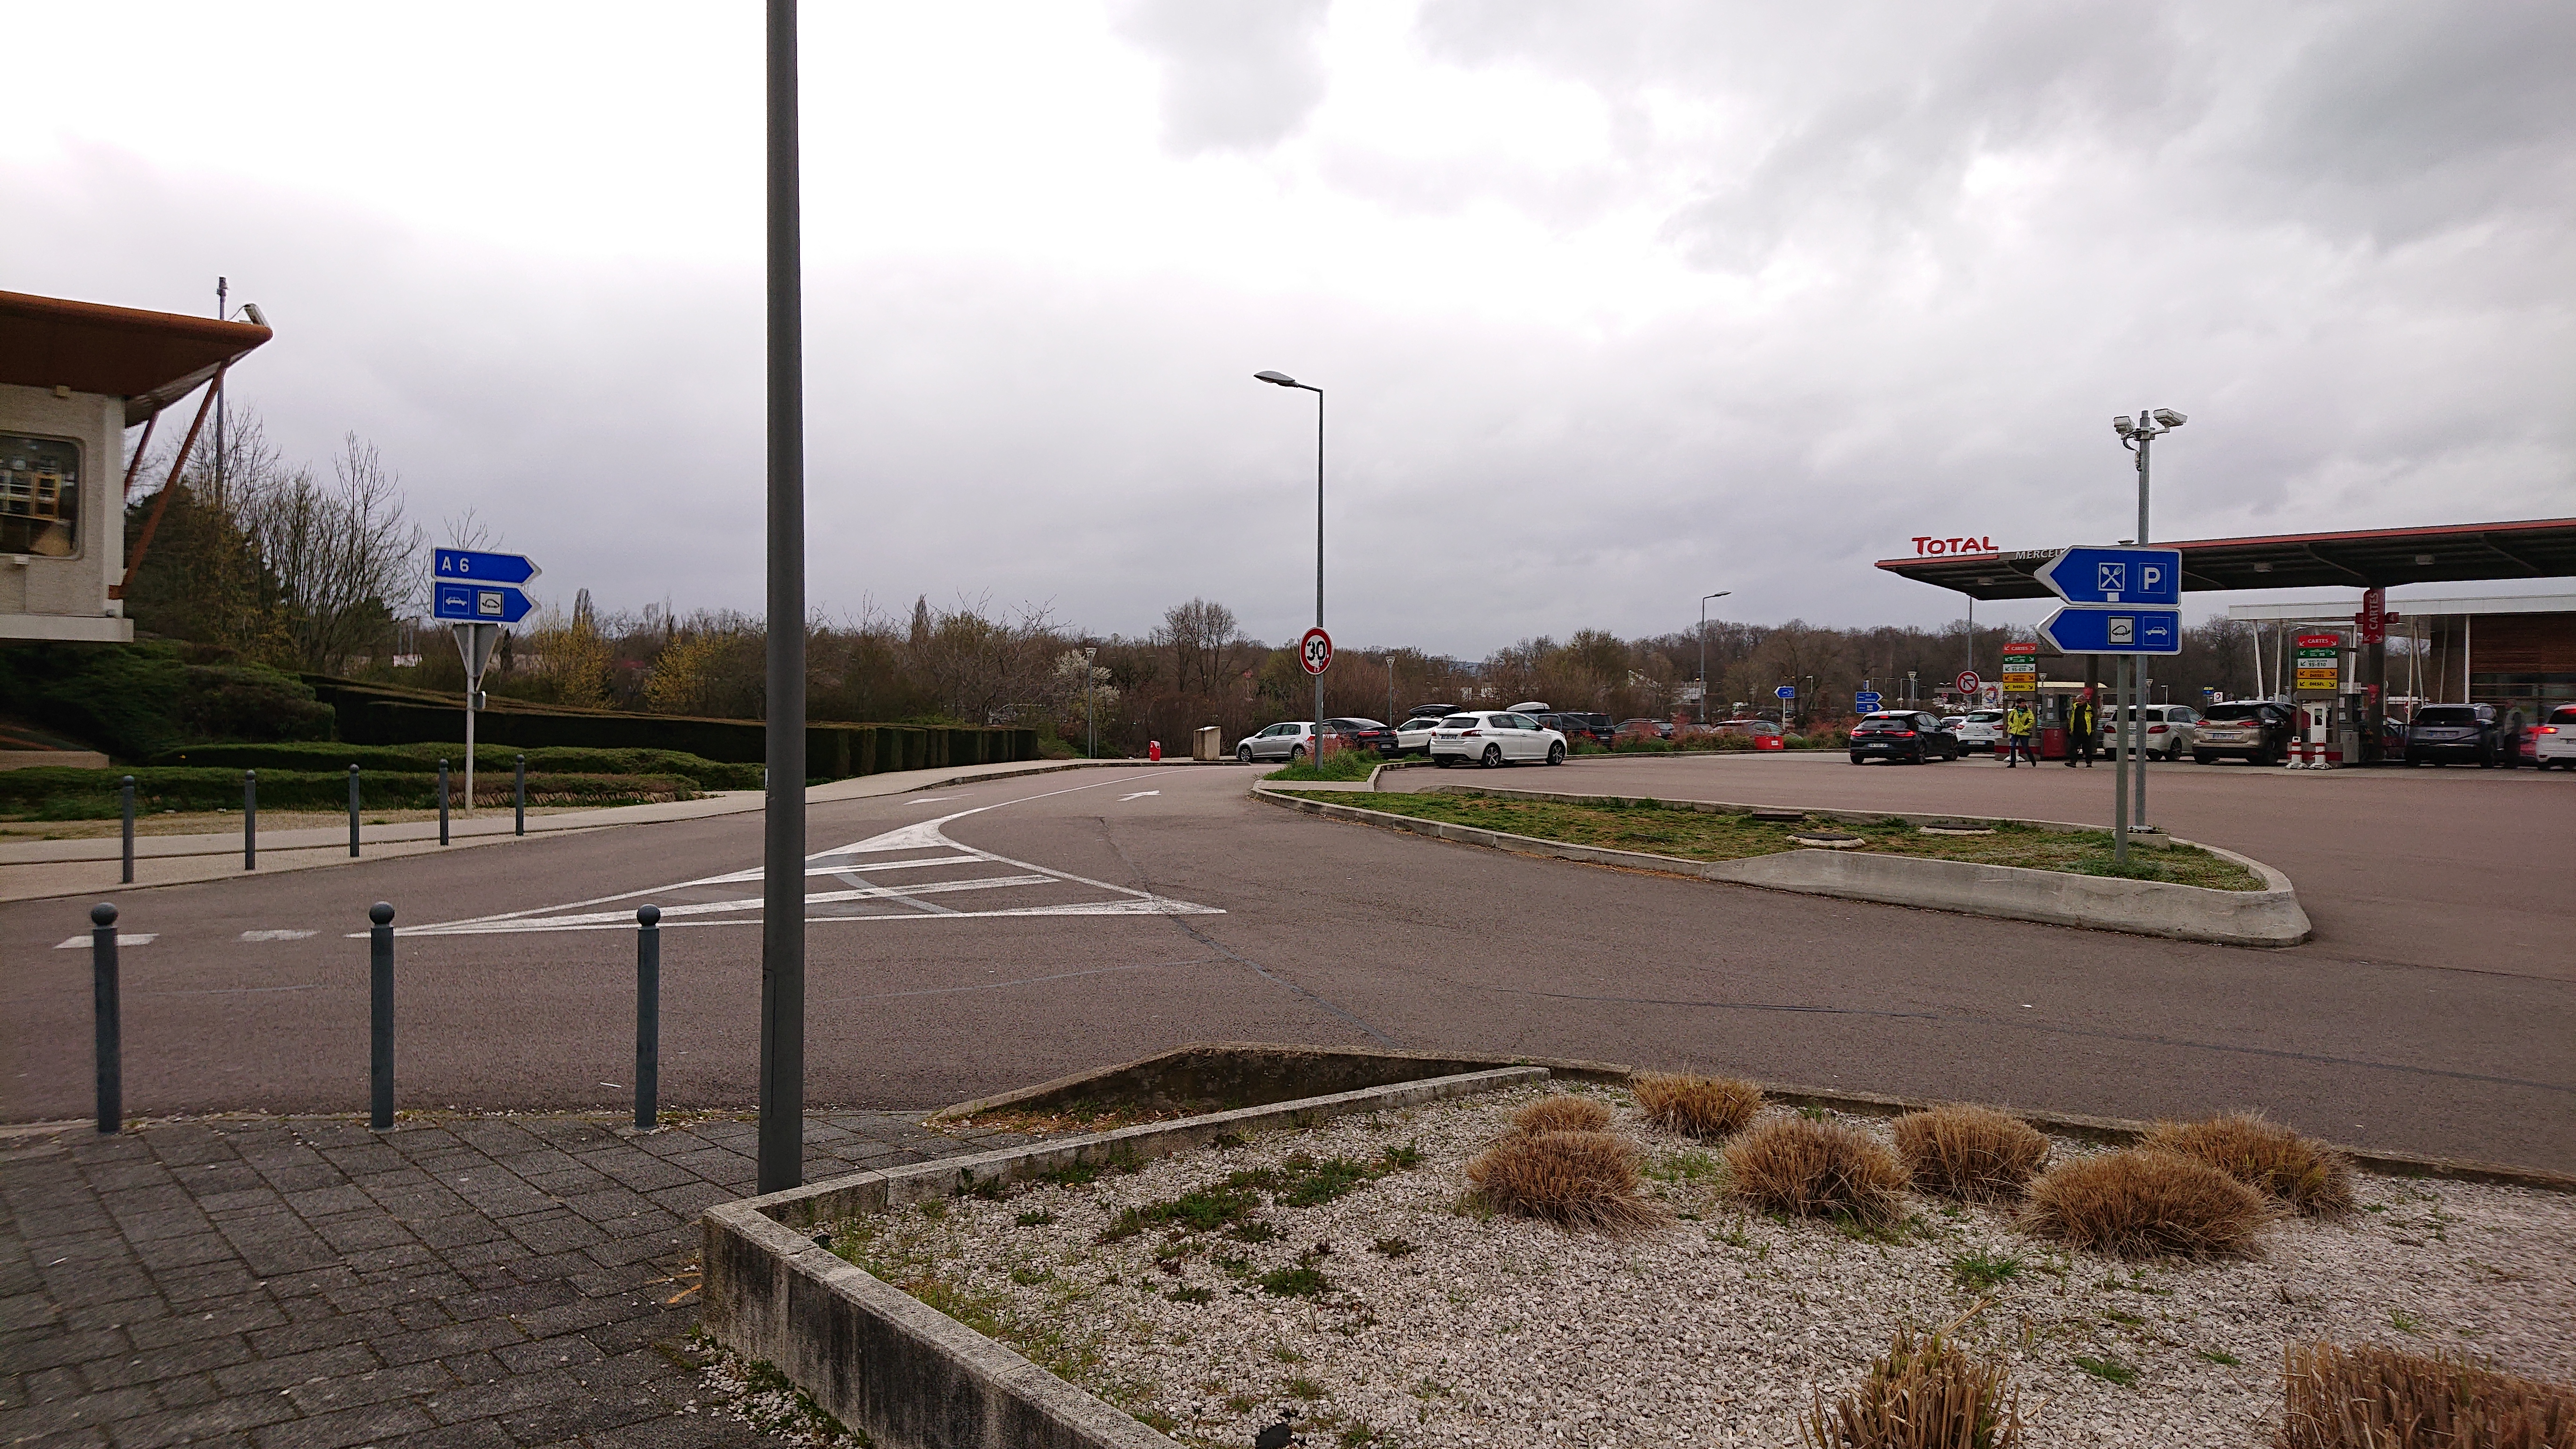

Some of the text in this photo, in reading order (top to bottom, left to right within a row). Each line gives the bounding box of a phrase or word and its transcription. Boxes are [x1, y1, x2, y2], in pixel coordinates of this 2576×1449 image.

[1911, 536, 1999, 555] TOTAL
[442, 556, 469, 572] A 6
[2144, 567, 2161, 590] P
[2369, 592, 2378, 630] CARTES
[1307, 640, 1326, 661] 30
